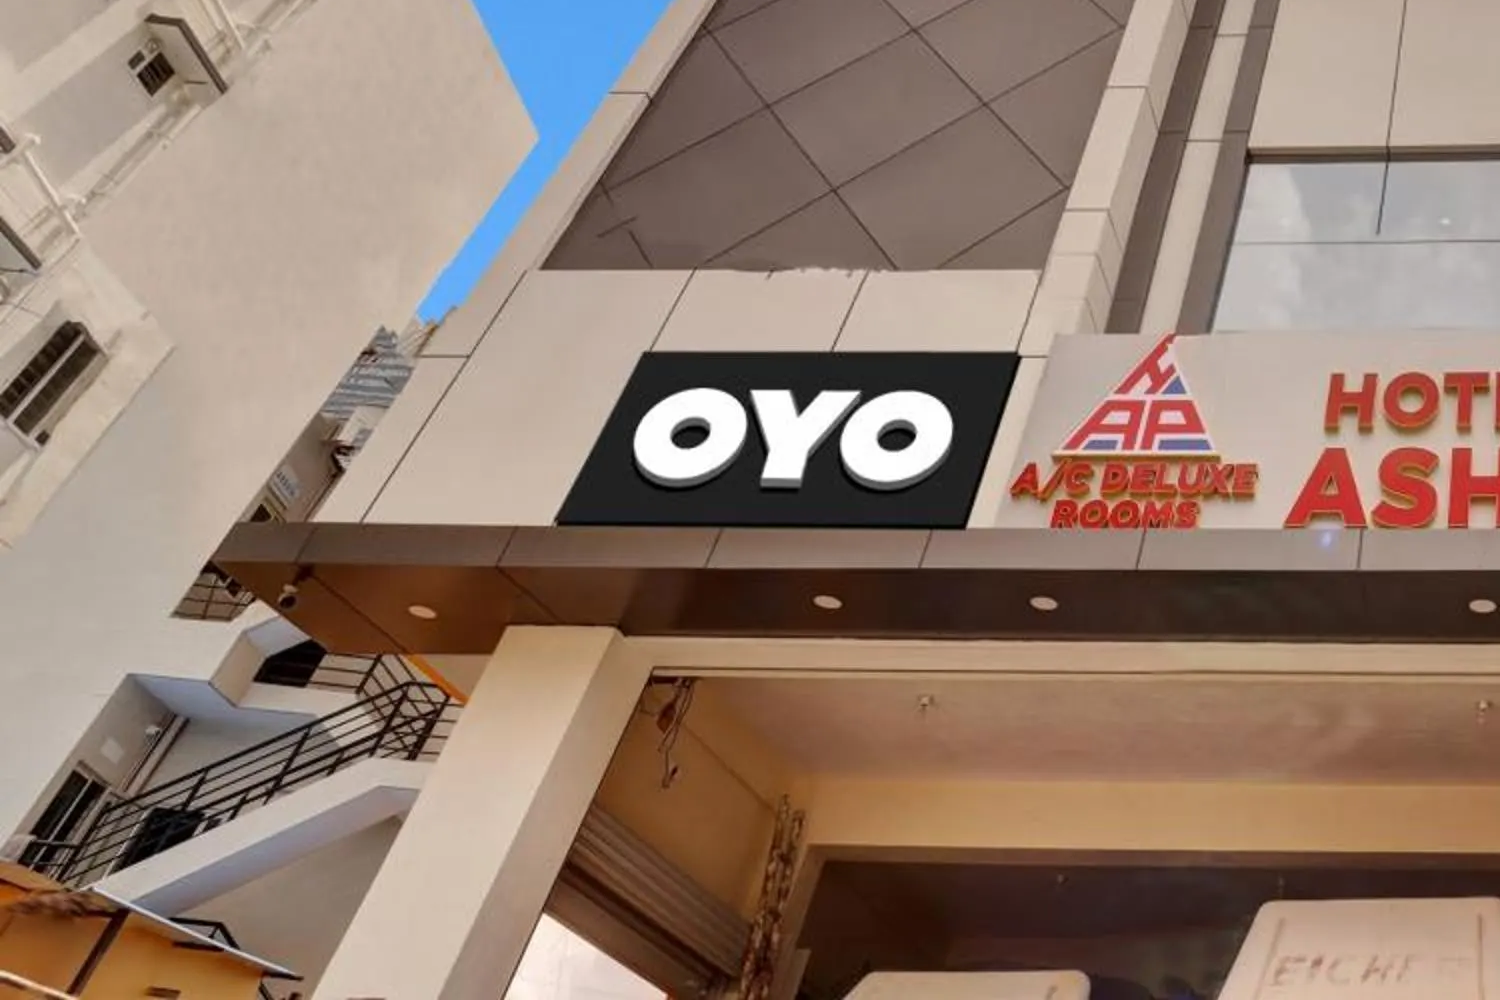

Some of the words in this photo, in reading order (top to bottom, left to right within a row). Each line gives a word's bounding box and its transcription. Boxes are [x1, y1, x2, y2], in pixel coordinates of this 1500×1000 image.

[633, 386, 954, 490] OYO
[1010, 458, 1095, 502] A/C
[1100, 462, 1259, 500] DELUXE
[1050, 499, 1200, 530] ROOMS
